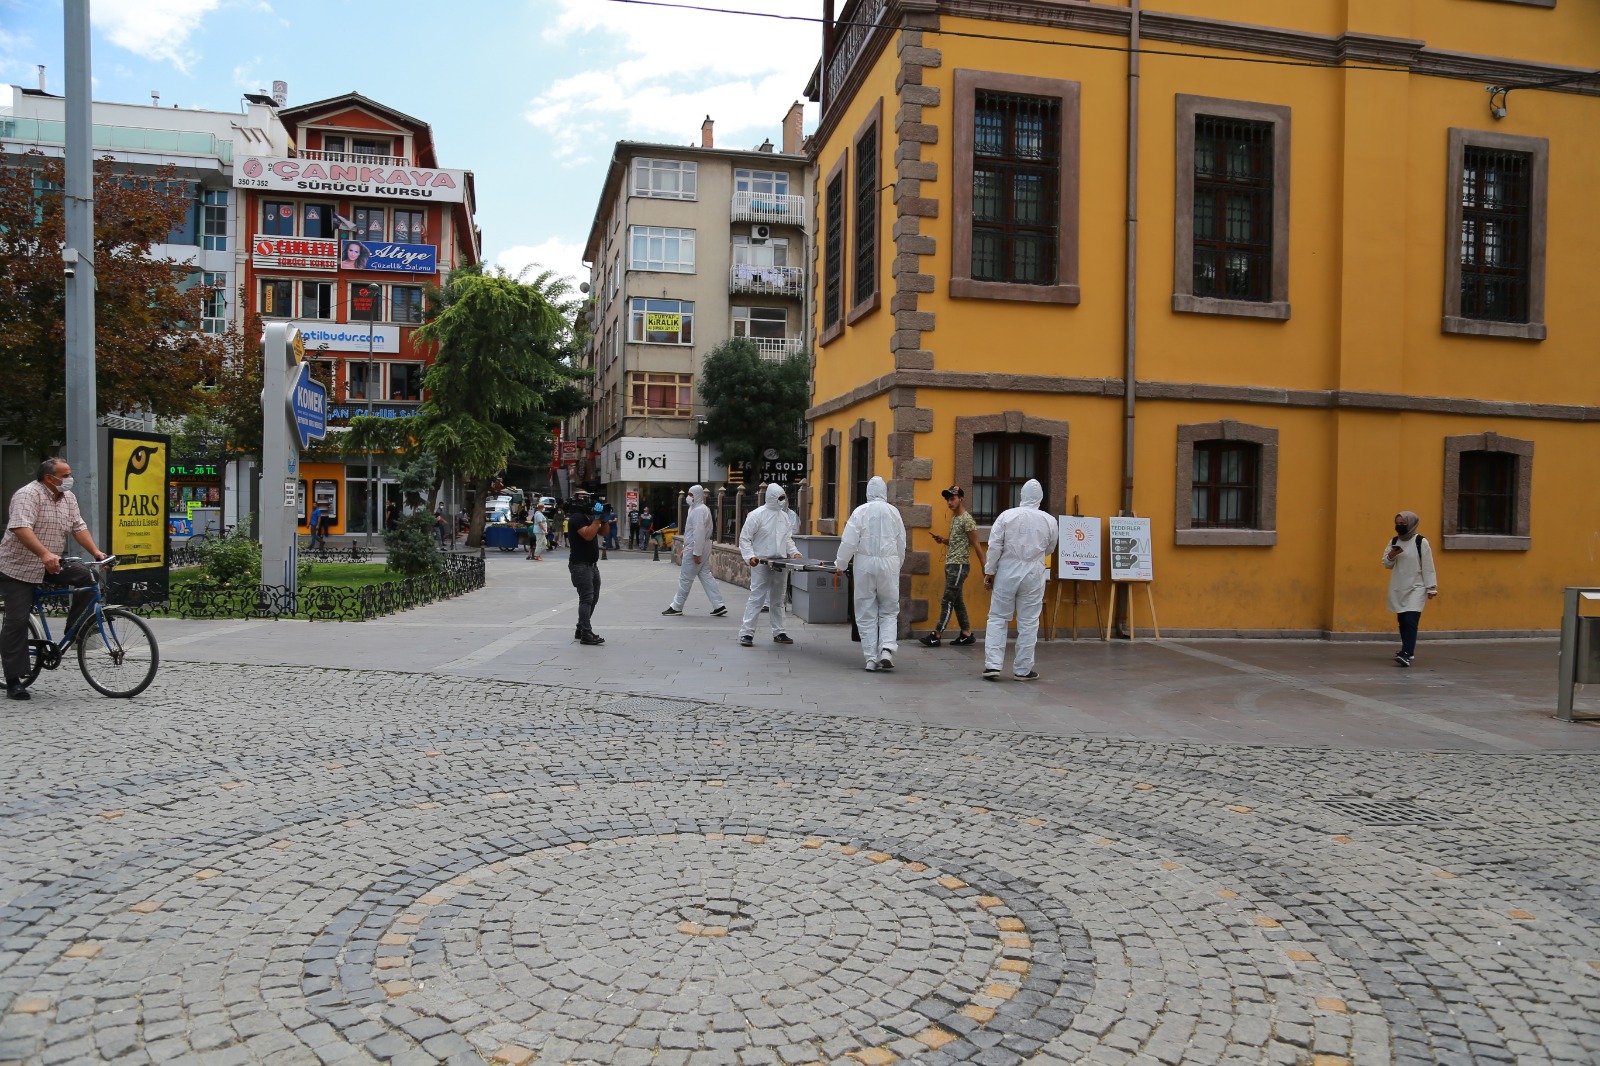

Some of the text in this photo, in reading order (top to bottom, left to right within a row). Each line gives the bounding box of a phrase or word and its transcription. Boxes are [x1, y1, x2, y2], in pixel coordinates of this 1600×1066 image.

[271, 161, 456, 189] ÇANKAYA
[238, 178, 250, 186] 350
[256, 179, 269, 187] 352
[297, 180, 433, 198] SÜRÜCÜ KURSU
[276, 239, 335, 257] ÇANKAYA
[370, 245, 432, 265] Aliye
[371, 262, 431, 272] Güzellik Salonu
[297, 385, 324, 414] KOMEK
[177, 466, 188, 475] TL
[205, 466, 217, 475] TL
[775, 462, 804, 471] GOLD
[759, 472, 788, 481] PTİK
[118, 494, 160, 517] PARS
[118, 518, 142, 528] Anadolu
